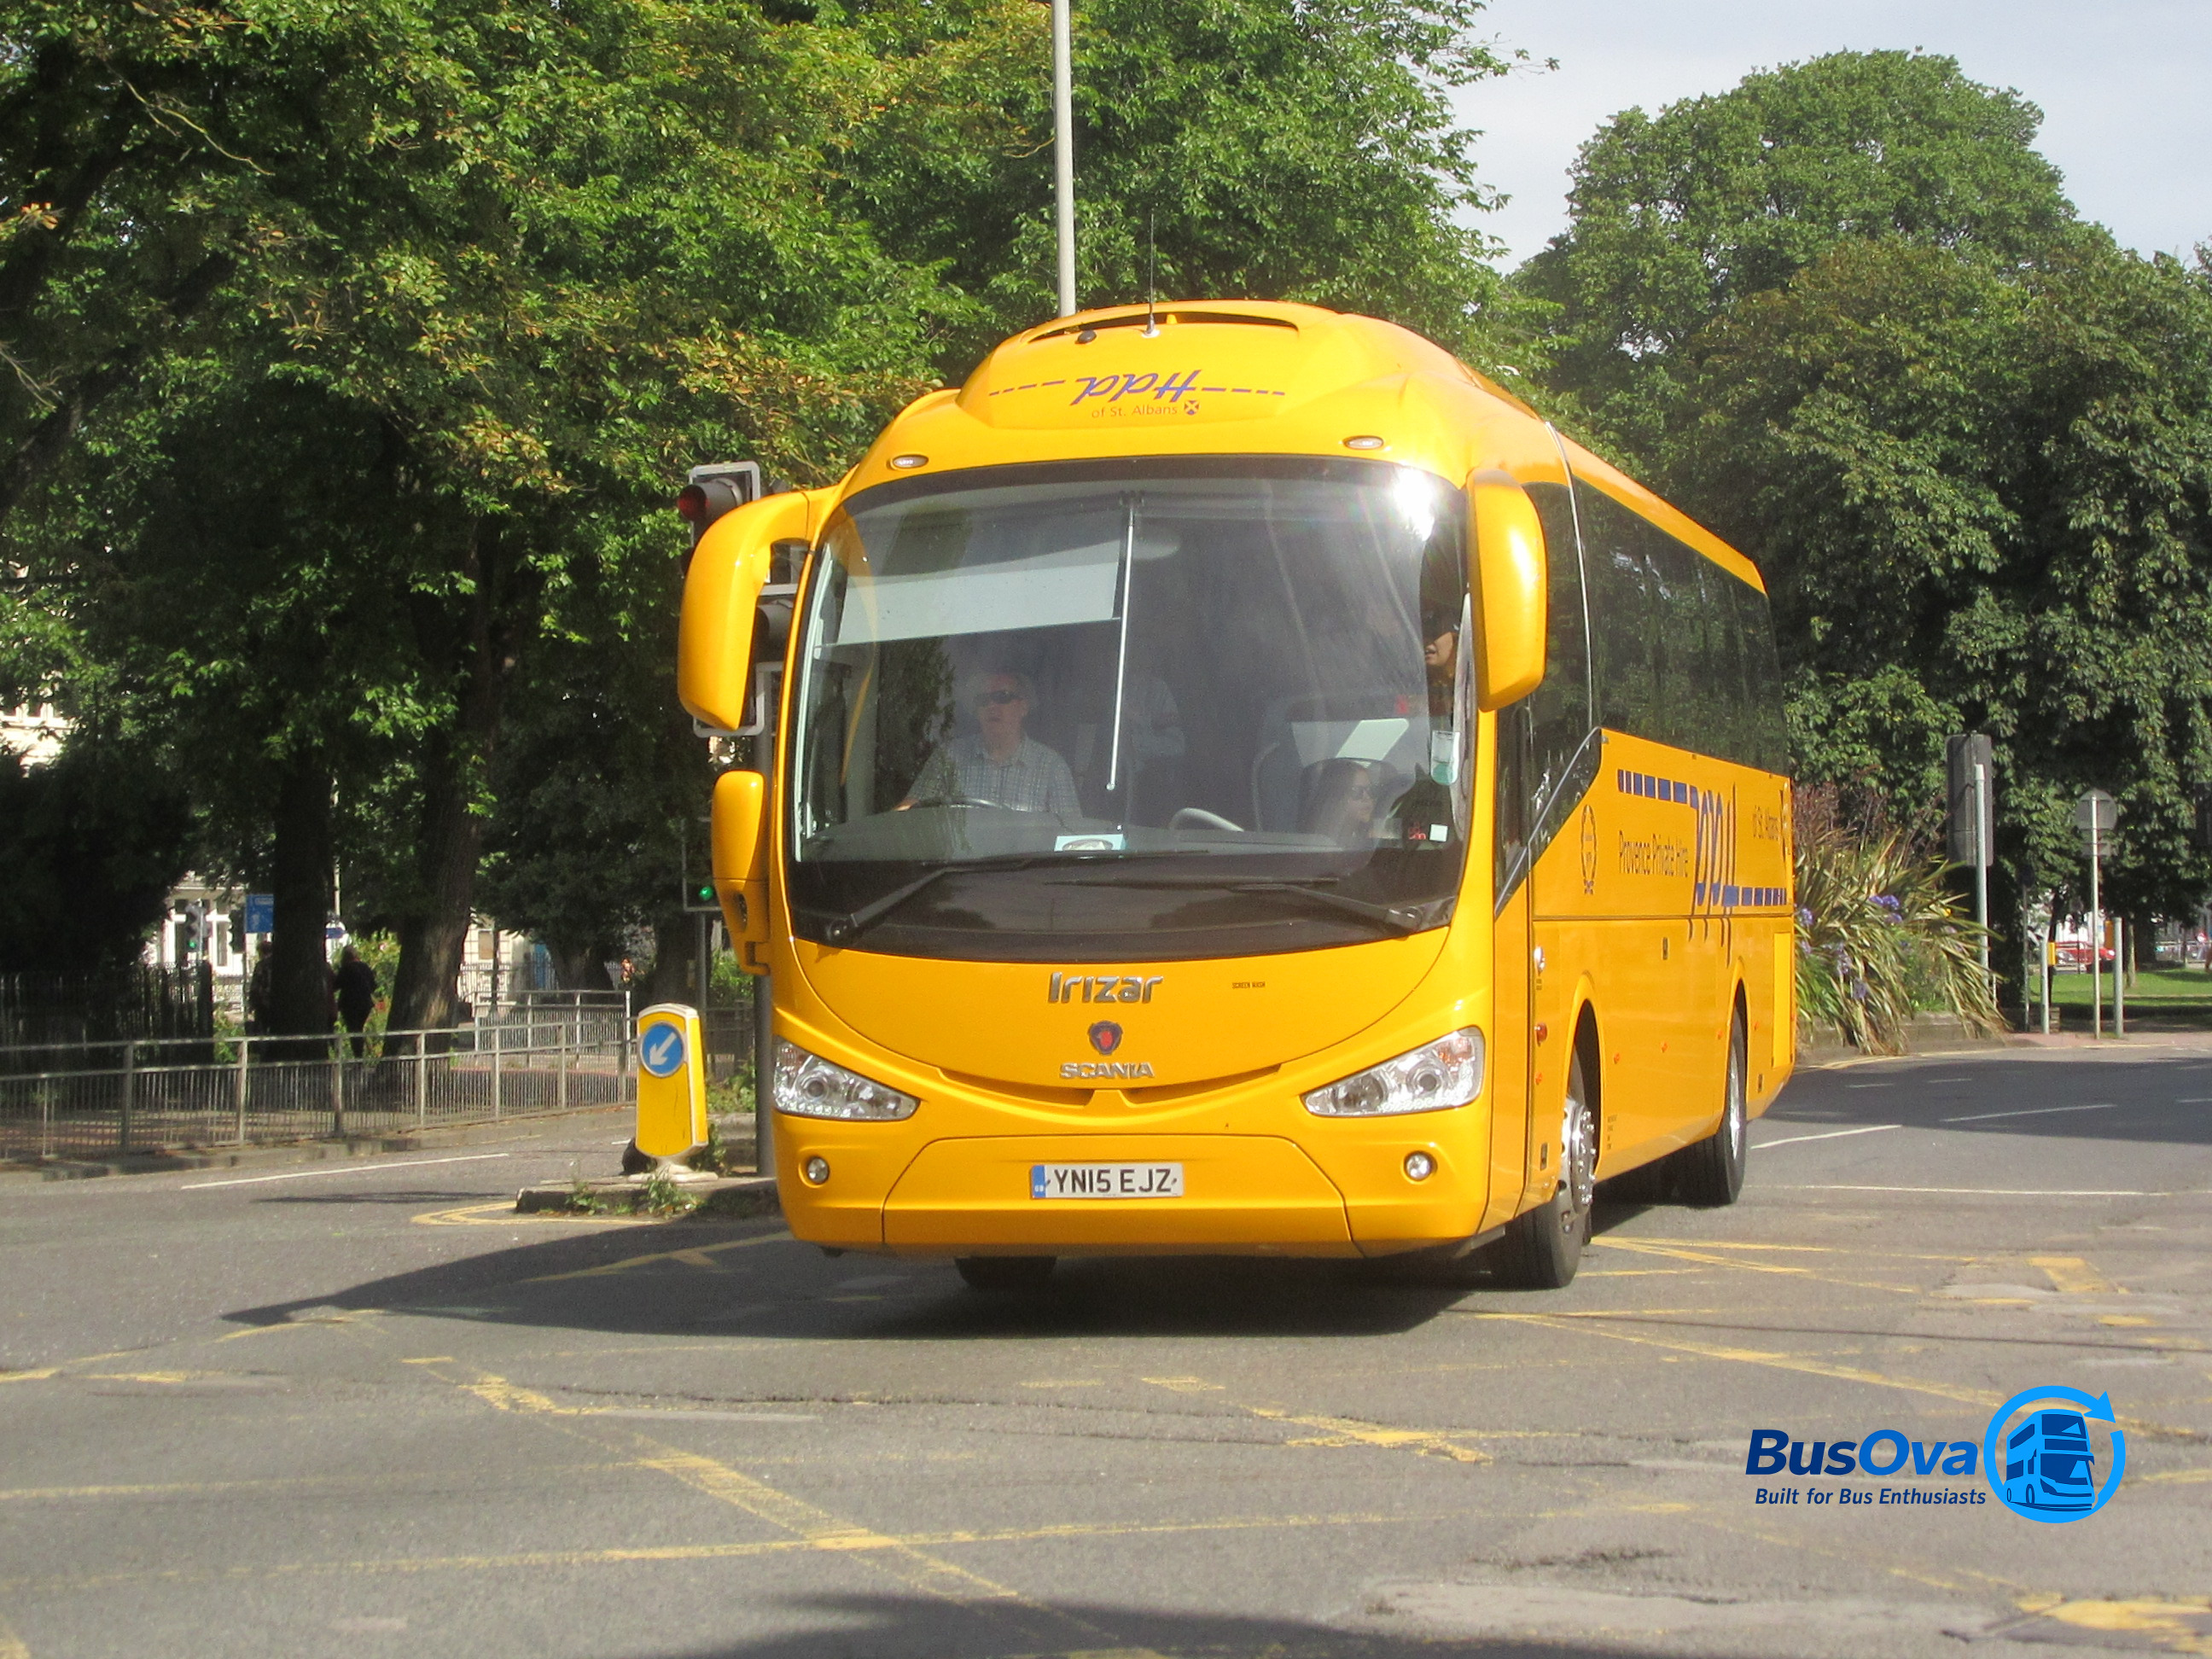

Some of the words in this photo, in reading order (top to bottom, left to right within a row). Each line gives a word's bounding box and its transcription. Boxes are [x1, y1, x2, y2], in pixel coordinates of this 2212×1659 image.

[1091, 405, 1106, 418] of
[1110, 405, 1126, 417] St.
[1132, 404, 1179, 416] Albans
[1048, 971, 1163, 1004] Irizar
[1060, 1062, 1155, 1079] SCANIA
[1054, 1168, 1111, 1193] YN15
[1120, 1168, 1171, 1193] EJZ
